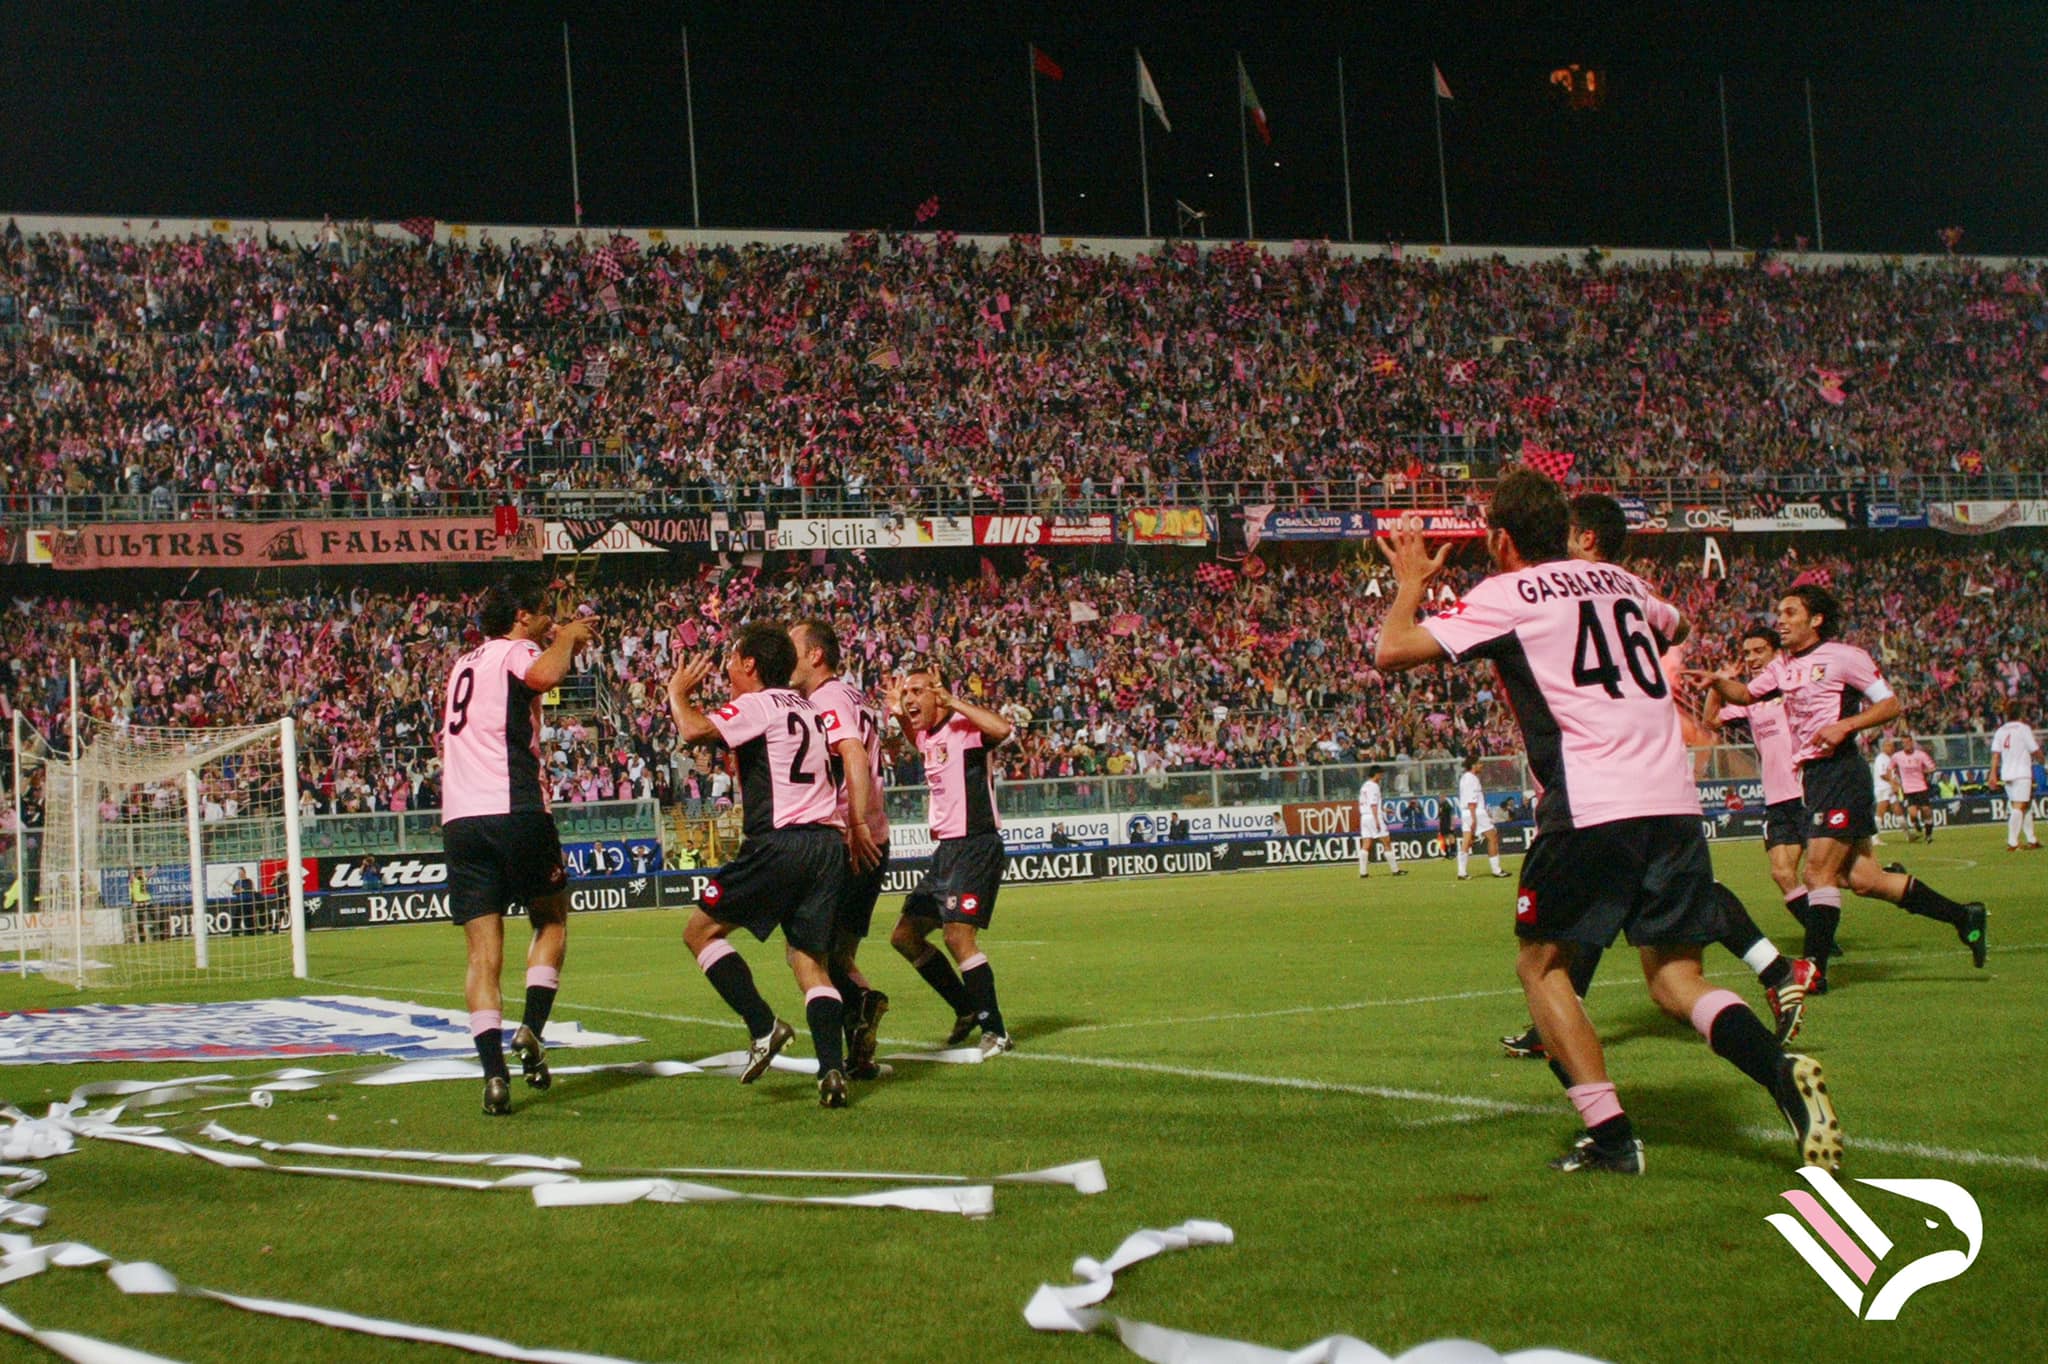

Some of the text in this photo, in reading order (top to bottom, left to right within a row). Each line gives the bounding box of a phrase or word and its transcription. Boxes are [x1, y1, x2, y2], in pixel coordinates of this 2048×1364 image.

[983, 516, 1043, 544] AVIS
[1685, 508, 1732, 528] COAS
[94, 528, 497, 557] ULTRAS FALANGE
[800, 521, 877, 546] Sicilia
[1702, 536, 1726, 579] A
[1572, 598, 1668, 700] 46
[449, 667, 475, 736] 9
[1156, 814, 1273, 832] Bca Nuova
[1375, 839, 1422, 862] PERO
[1002, 852, 1094, 880] AGAGLI
[1107, 851, 1213, 876] PIERO GUIDI
[881, 869, 930, 891] GUID
[570, 887, 627, 911] GUIDI
[169, 911, 232, 936] PIRO
